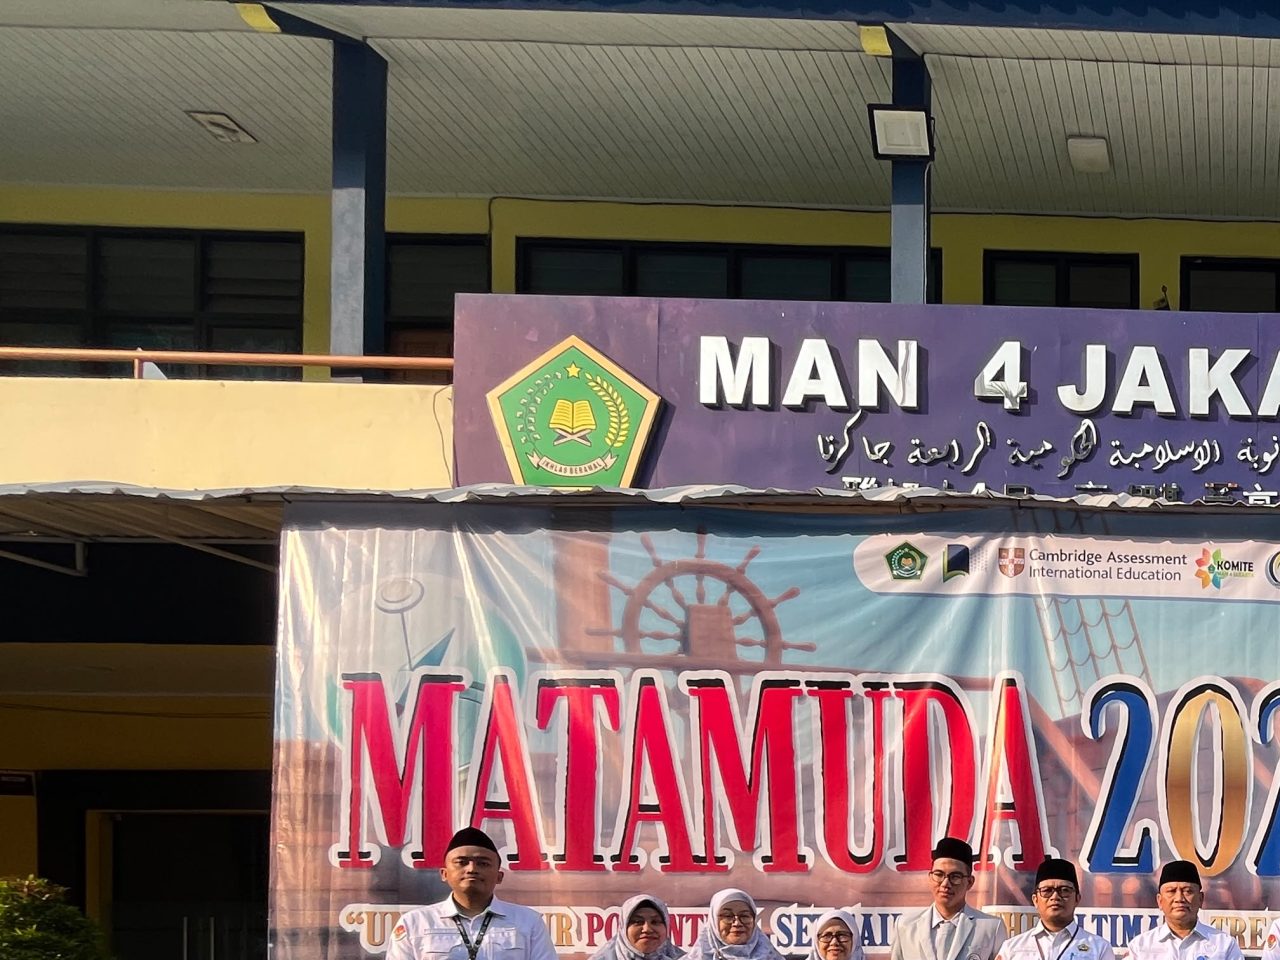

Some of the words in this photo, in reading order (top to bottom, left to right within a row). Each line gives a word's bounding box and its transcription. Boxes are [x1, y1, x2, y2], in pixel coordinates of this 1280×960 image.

[700, 336, 919, 410] MAN
[974, 341, 1029, 413] 4
[1029, 548, 1102, 565] Cambridge
[1106, 551, 1188, 565] Assessment
[1029, 565, 1112, 580] International
[1116, 567, 1182, 581] Education
[1216, 560, 1254, 572] KOMITE
[336, 671, 1052, 873] MATAMUDA
